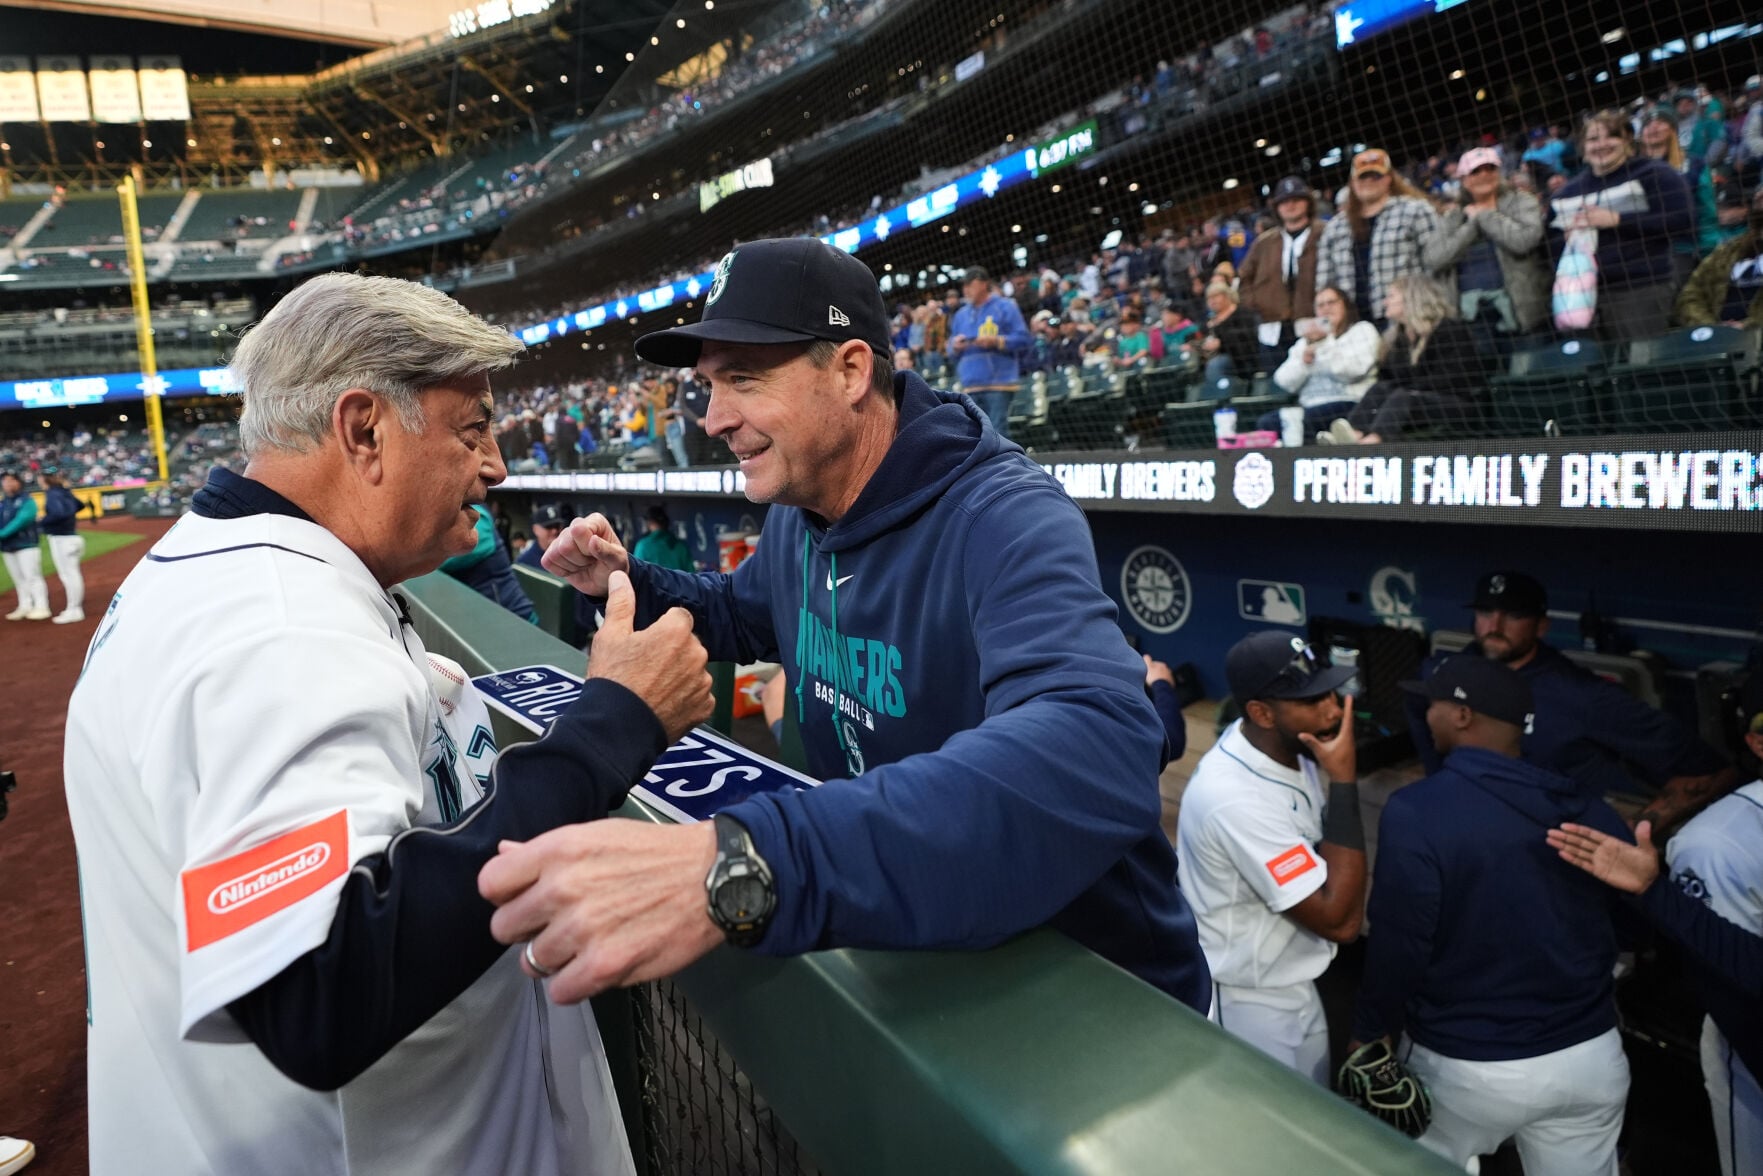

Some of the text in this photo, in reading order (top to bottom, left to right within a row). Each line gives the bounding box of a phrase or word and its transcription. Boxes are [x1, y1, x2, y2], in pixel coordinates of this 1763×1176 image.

[1054, 460, 1216, 502] FAMILY BREWERS
[1294, 457, 1402, 504] PFRIEM
[1413, 454, 1548, 506] FAMILY
[796, 608, 907, 718] MANERS
[501, 681, 583, 722] RIC
[815, 681, 861, 721] BASBALL
[219, 851, 321, 908] Nintendo
